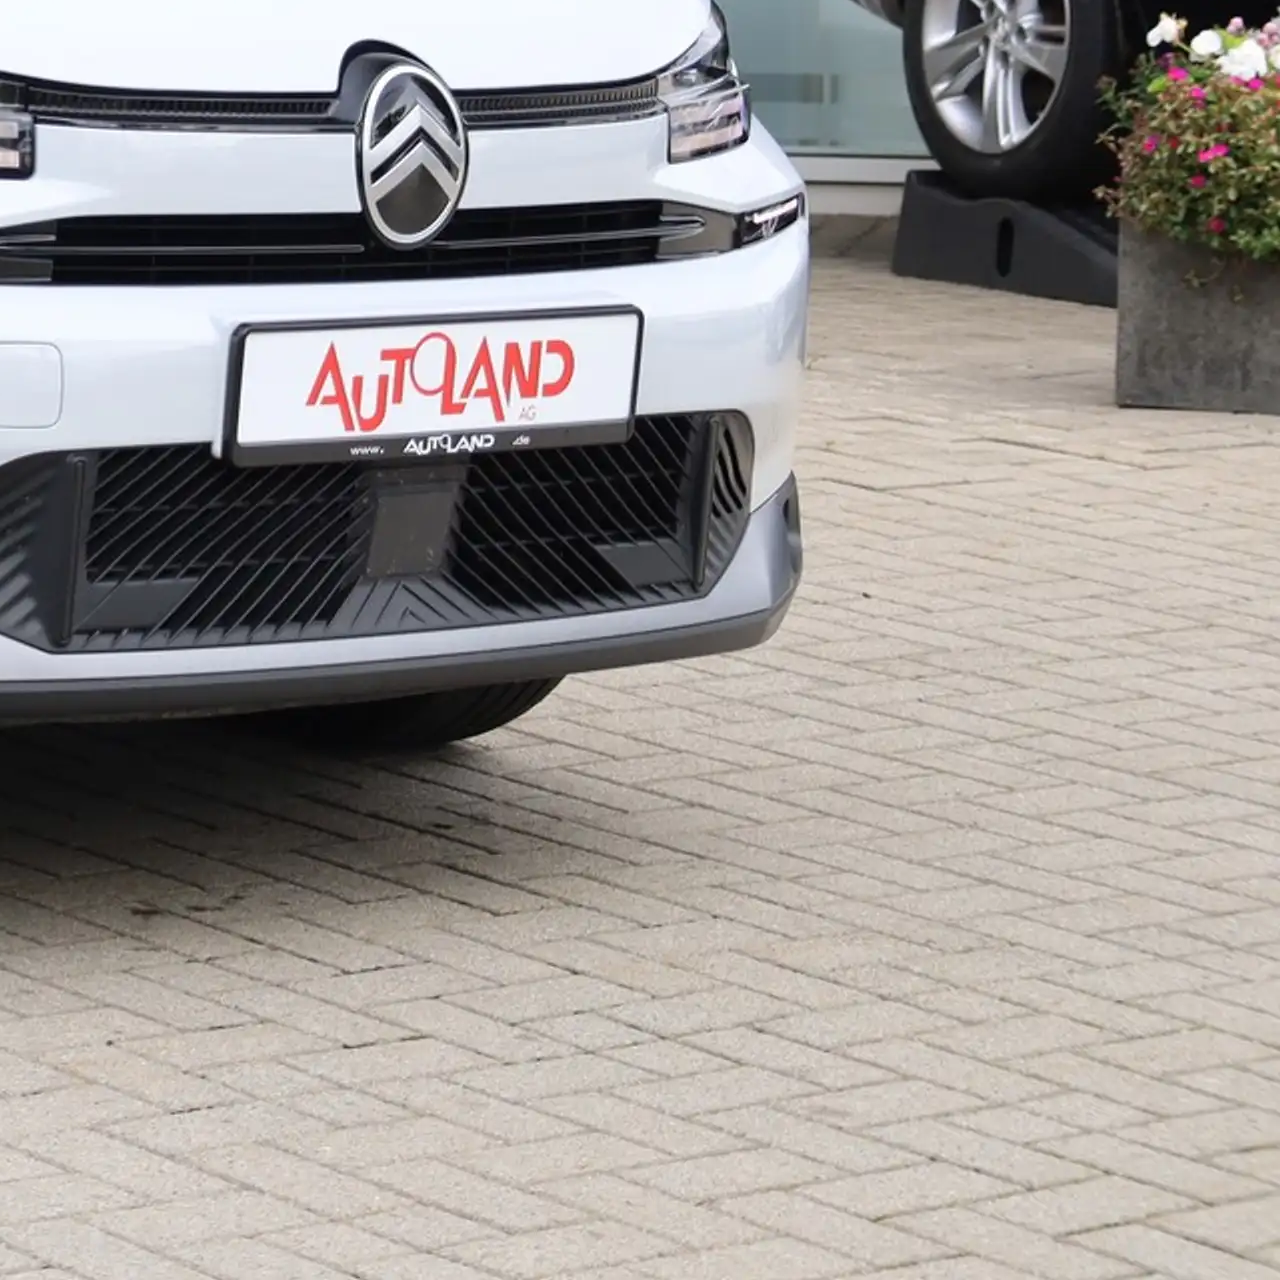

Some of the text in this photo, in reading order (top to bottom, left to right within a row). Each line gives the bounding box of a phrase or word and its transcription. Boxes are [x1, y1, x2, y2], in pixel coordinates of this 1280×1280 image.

[306, 332, 574, 432] AUTOLAND
[518, 404, 537, 422] AG
[350, 445, 385, 456] www.
[403, 434, 496, 455] AUTOLAND
